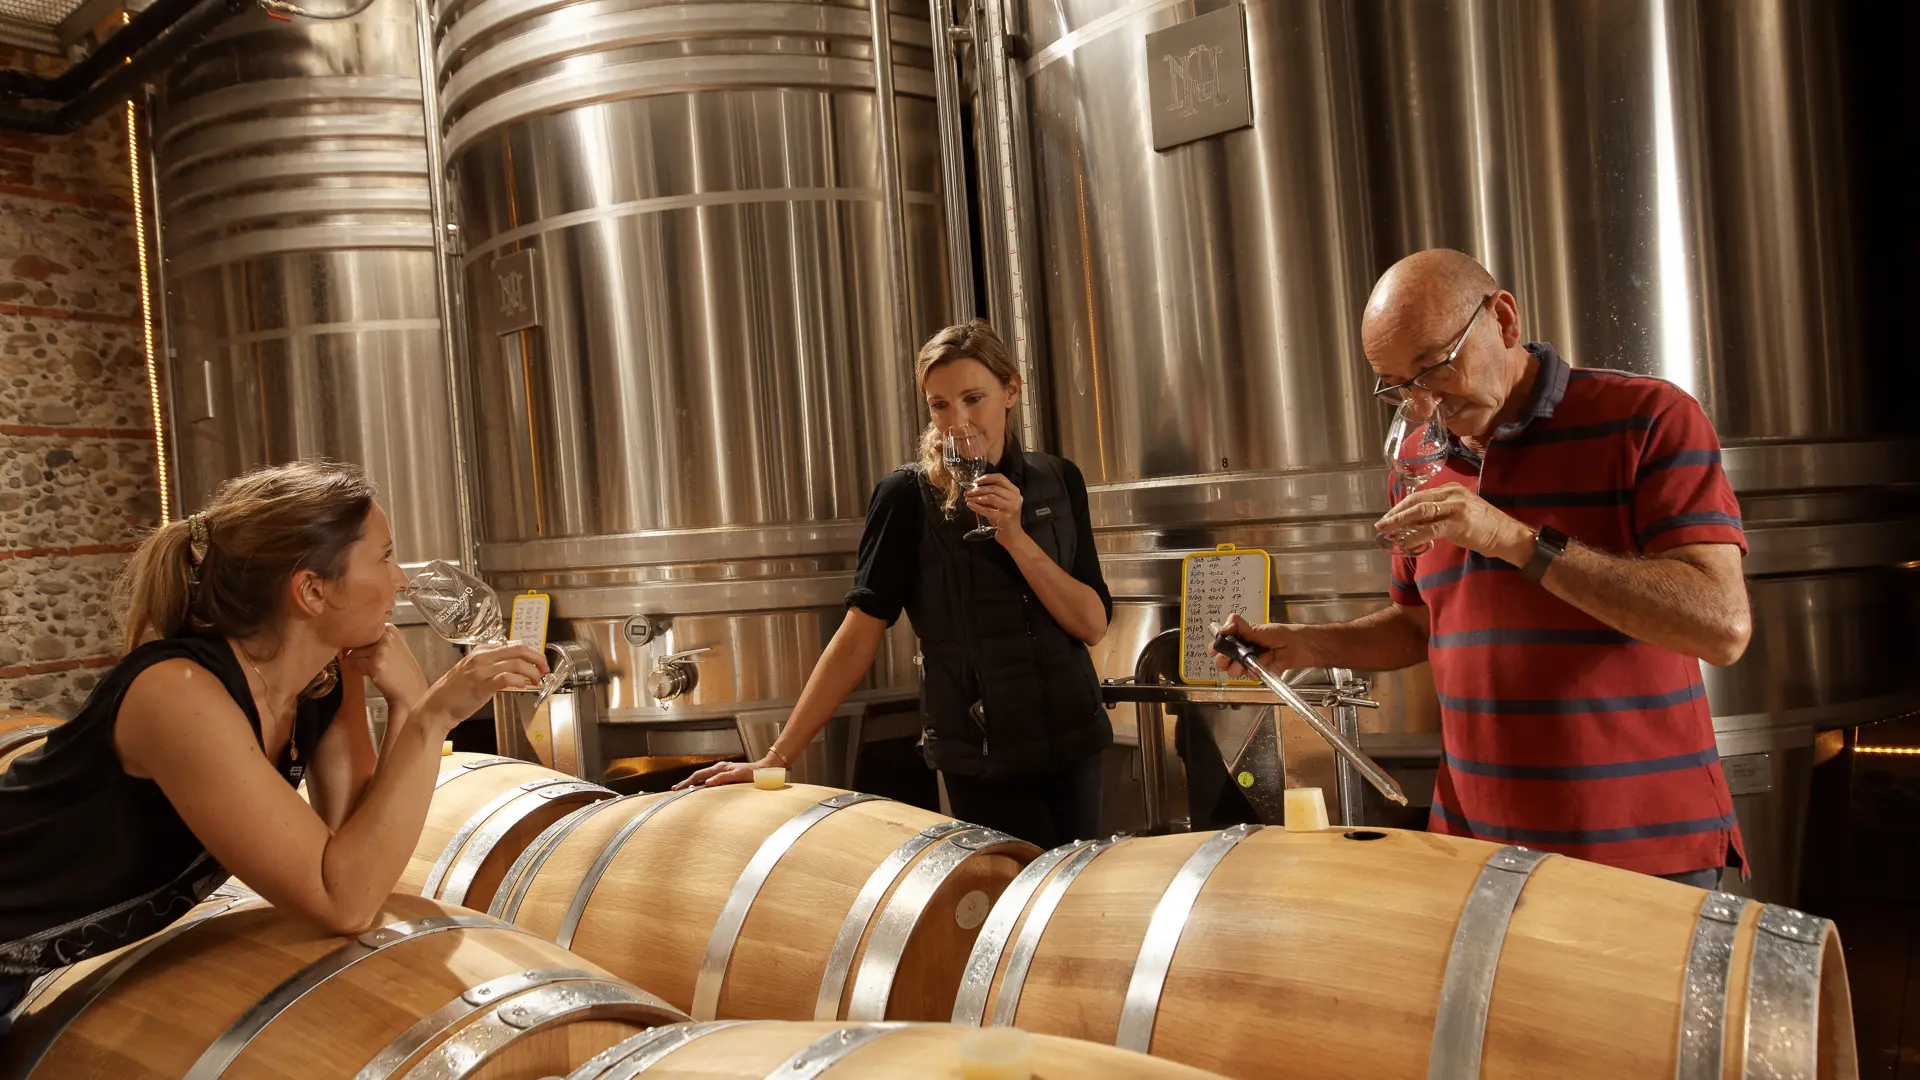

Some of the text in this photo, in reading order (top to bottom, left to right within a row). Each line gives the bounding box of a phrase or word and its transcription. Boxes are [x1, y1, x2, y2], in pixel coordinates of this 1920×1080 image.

[1222, 457, 1229, 468] 8
[1210, 578, 1228, 586] 1023
[1185, 650, 1208, 658] 18/09
